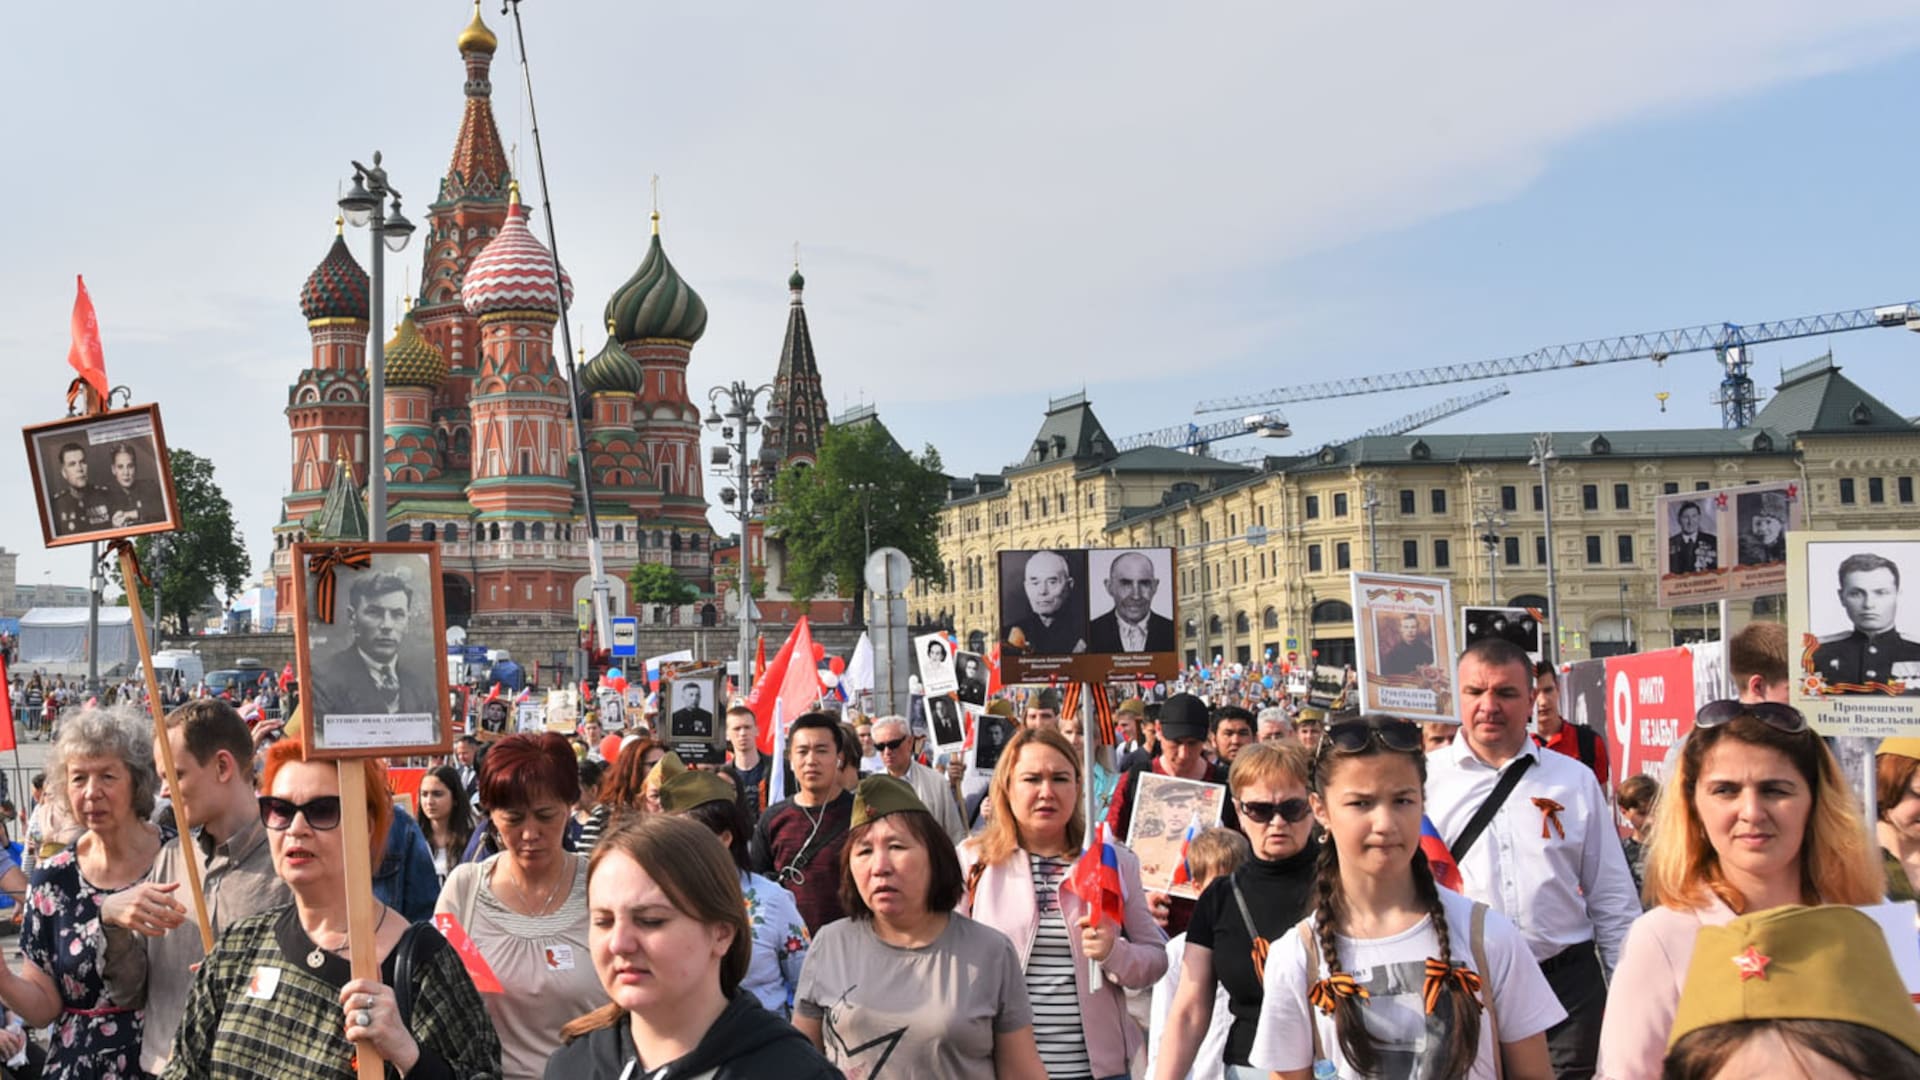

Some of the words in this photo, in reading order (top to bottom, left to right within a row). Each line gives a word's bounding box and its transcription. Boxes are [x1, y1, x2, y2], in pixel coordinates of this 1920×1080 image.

[1638, 676, 1664, 704] НИКТО
[1640, 718, 1650, 746] НЕ
[1855, 714, 1920, 725] Васильеви
